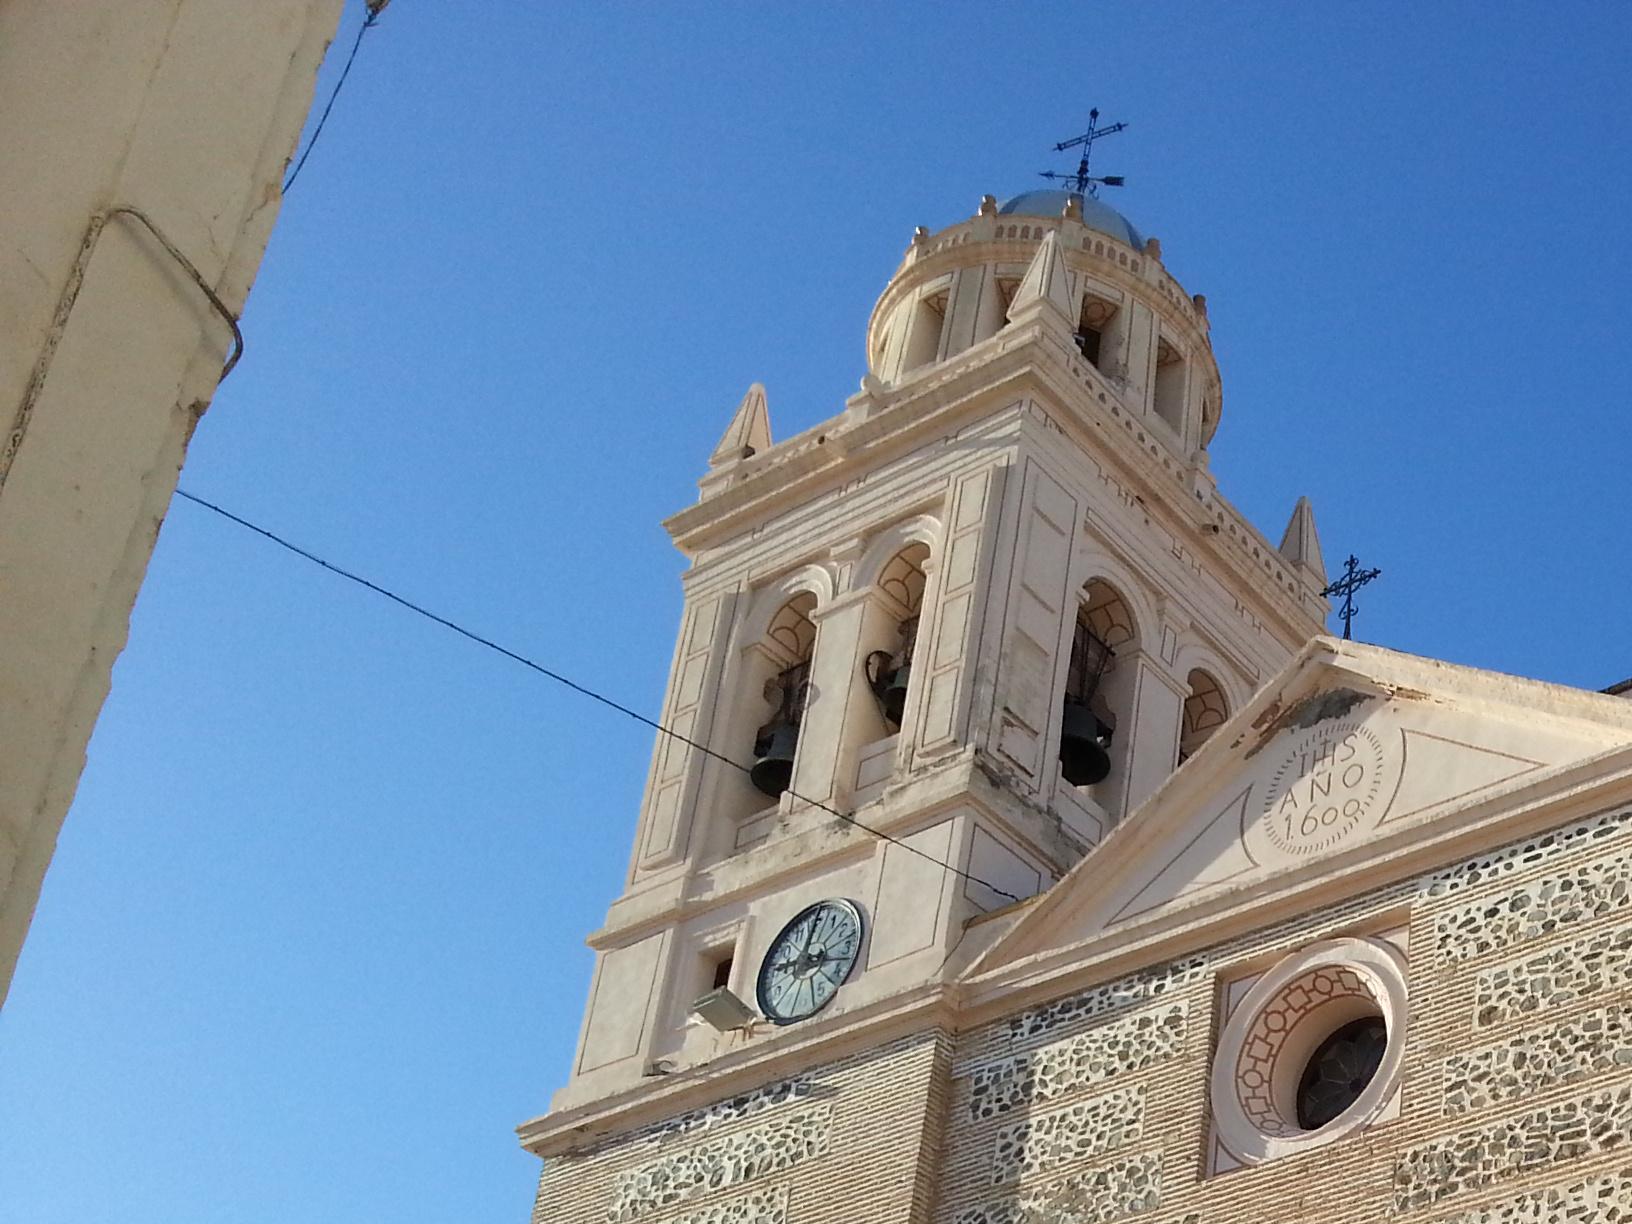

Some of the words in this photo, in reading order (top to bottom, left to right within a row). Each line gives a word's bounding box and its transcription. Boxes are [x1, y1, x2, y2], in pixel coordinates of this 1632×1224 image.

[1279, 763, 1364, 815] AÑO
[841, 940, 852, 956] 3
[816, 980, 826, 998] 5
